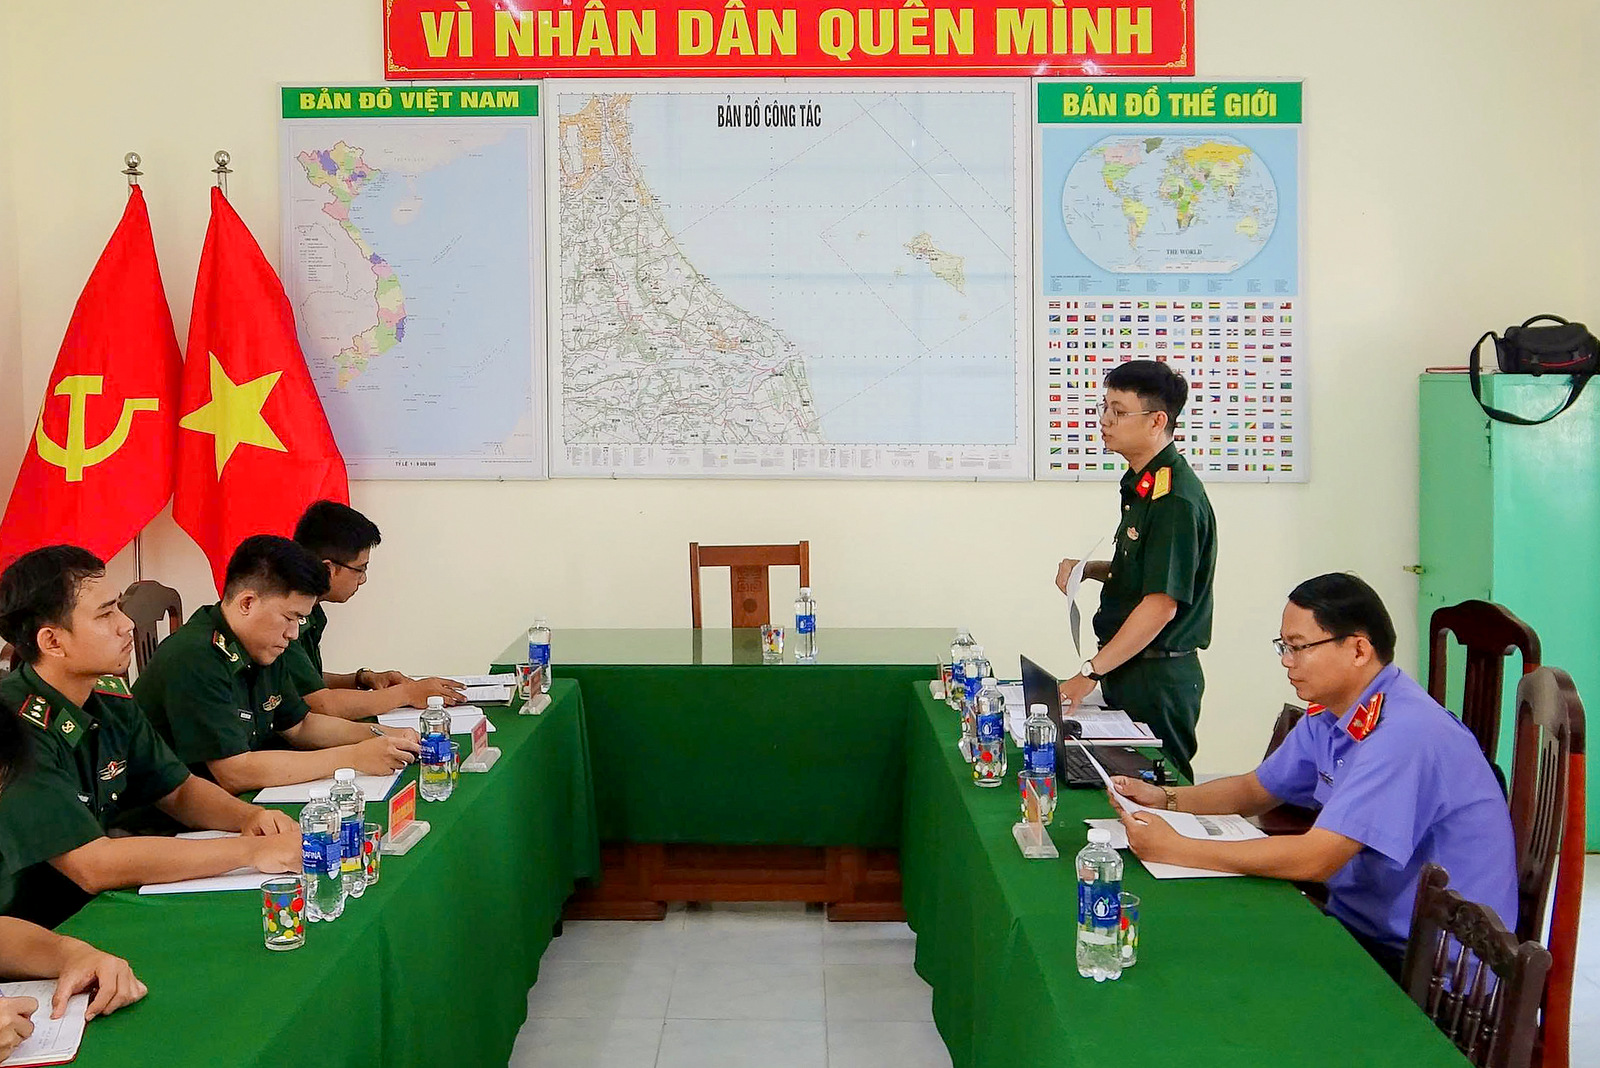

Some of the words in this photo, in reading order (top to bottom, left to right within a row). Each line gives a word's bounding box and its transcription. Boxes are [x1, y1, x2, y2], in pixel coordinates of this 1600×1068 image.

[420, 1, 474, 57] VÌ
[495, 0, 656, 57] NHÂN
[678, 0, 797, 56] DÂN
[818, 0, 974, 61] QUÊN
[996, 0, 1153, 55] MÌNH
[299, 88, 352, 110] BẢN
[358, 87, 393, 110] ĐỒ
[400, 89, 453, 112] VIỆT
[460, 91, 520, 108] NAM
[717, 95, 742, 128] BẢN
[745, 97, 760, 128] ĐỒ
[764, 100, 796, 128] CÔNG
[799, 99, 822, 128] TÁC
[1063, 86, 1118, 117] BẢN
[1124, 86, 1162, 117] ĐỒ
[1168, 86, 1218, 117] THẾ
[1224, 90, 1277, 117] GIỚI
